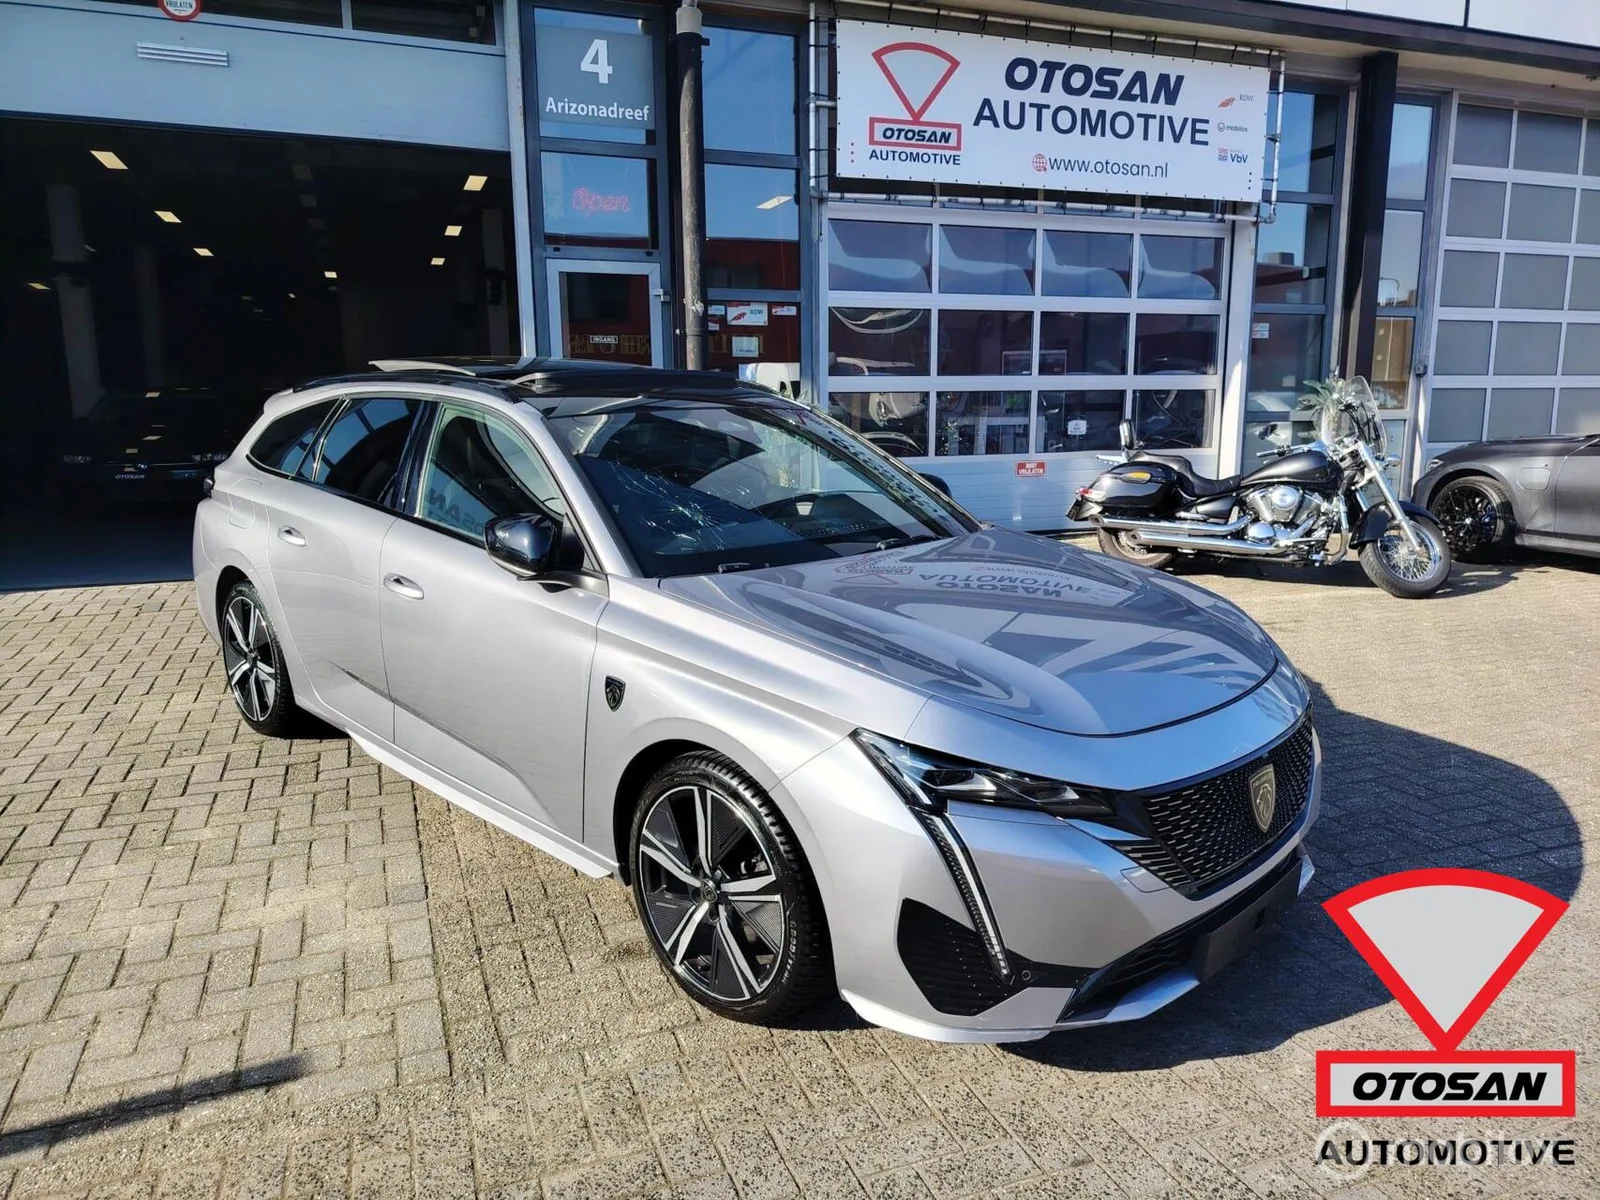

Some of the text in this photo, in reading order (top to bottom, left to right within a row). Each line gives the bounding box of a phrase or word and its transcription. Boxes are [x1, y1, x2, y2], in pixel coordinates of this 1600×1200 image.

[580, 39, 613, 84] 4
[1005, 57, 1185, 106] OTOSAN
[545, 96, 650, 121] Arizonadreef
[972, 98, 1210, 146] AUTOMOTIVE
[882, 127, 952, 144] OTOSAN
[869, 149, 961, 166] AUTOMOTIVE
[1048, 157, 1169, 178] www.otosan.nl
[1230, 153, 1248, 163] VbV
